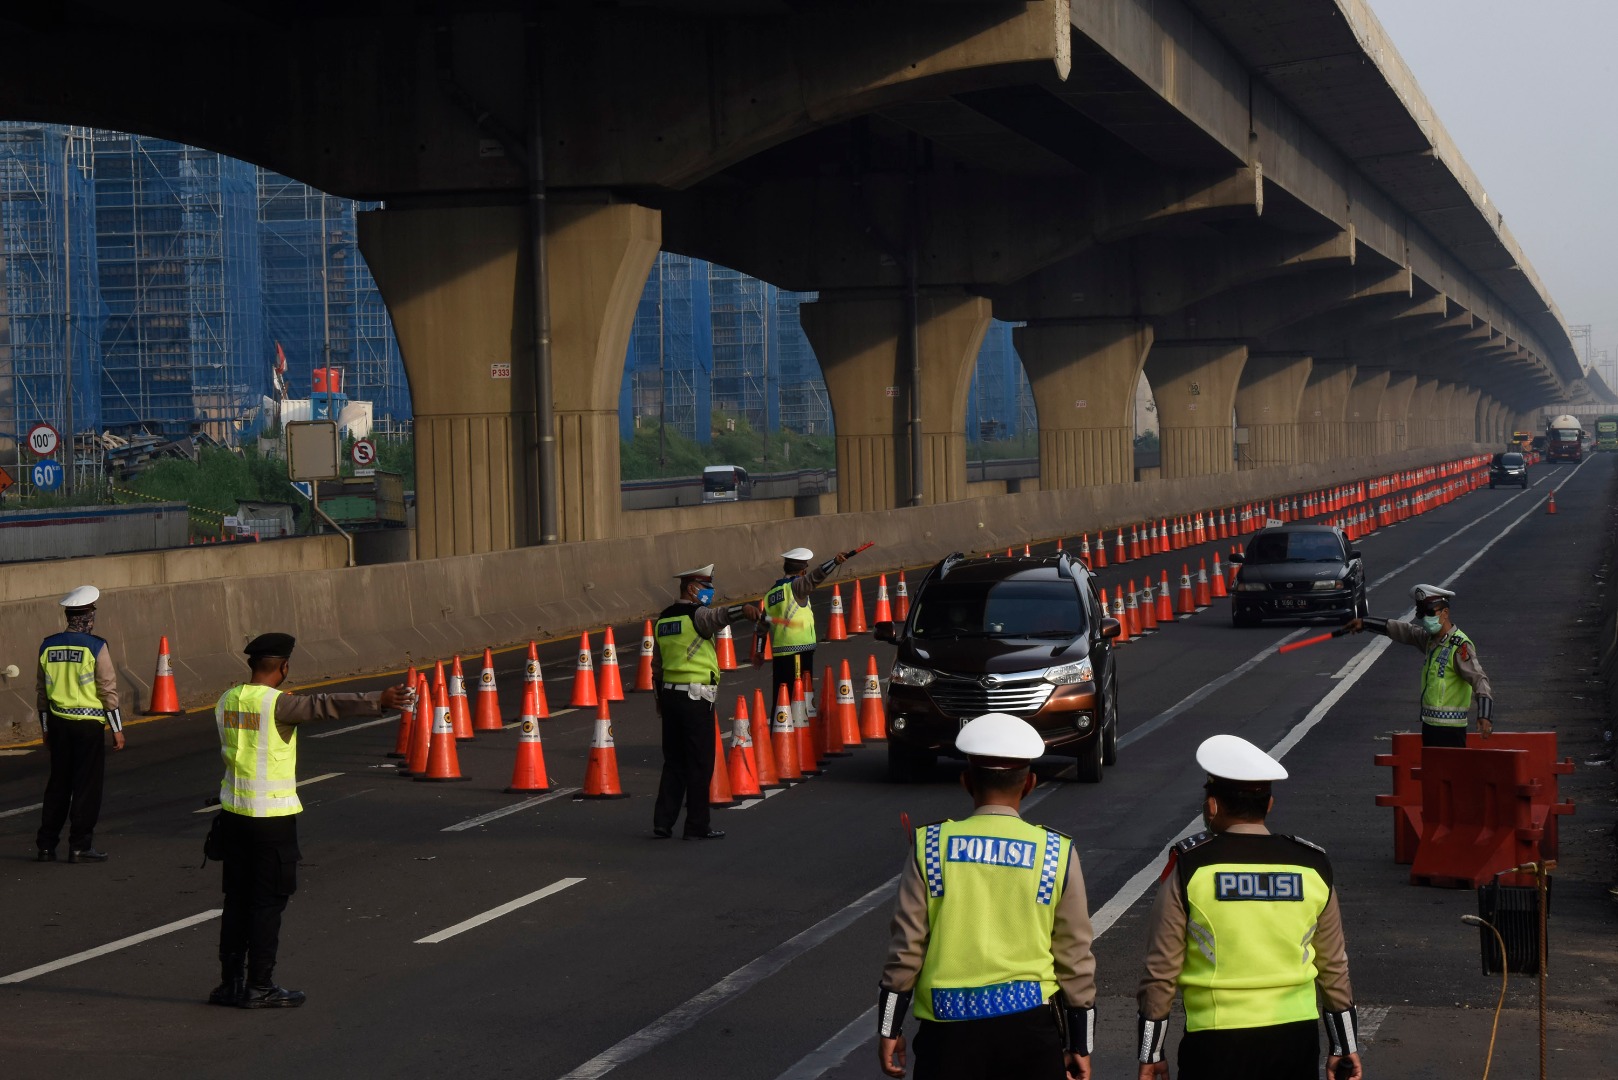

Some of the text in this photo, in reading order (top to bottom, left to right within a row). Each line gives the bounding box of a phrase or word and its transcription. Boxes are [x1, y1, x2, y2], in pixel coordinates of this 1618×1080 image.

[33, 433, 49, 448] 100
[34, 465, 54, 486] 60
[768, 590, 784, 606] POISI
[49, 650, 83, 662] POLISI
[950, 837, 1034, 867] POLISI
[1219, 873, 1300, 897] POLISI
